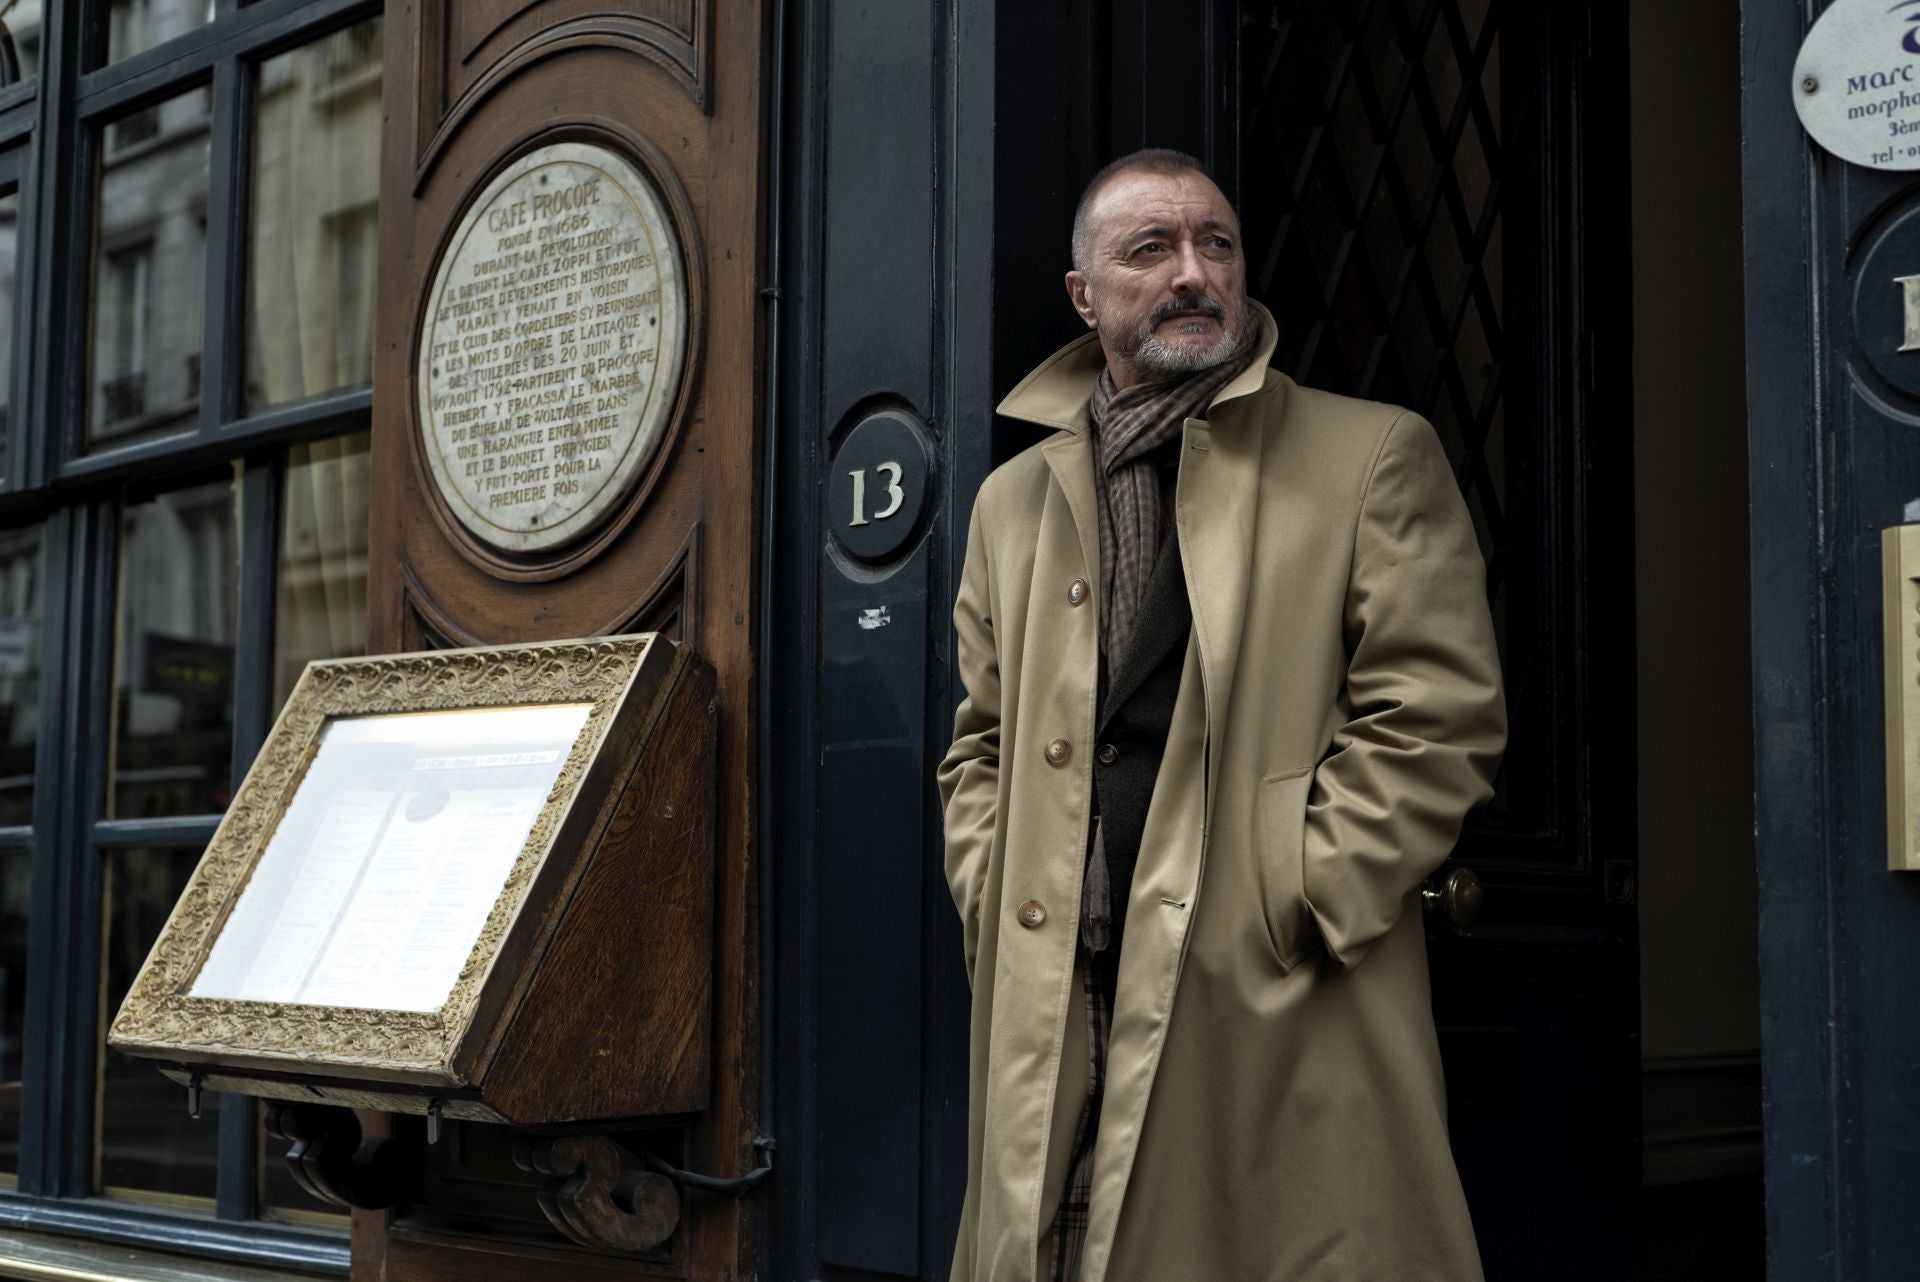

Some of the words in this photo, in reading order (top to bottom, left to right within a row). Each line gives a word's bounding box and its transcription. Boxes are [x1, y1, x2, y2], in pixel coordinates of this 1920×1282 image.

[533, 180, 601, 221] PROCOPE
[539, 225, 551, 240] EN
[556, 211, 590, 235] 1686
[460, 277, 499, 299] DEVINT
[503, 272, 516, 287] LE
[555, 252, 590, 273] ZOPPI
[597, 246, 612, 263] ET
[474, 252, 521, 277] DURANT
[525, 248, 537, 264] LA
[439, 307, 450, 321] LE
[456, 311, 498, 335] MARAT
[503, 308, 510, 323] Y
[516, 296, 558, 319] VENAIT
[567, 291, 582, 307] EN
[591, 279, 629, 301] VOISIN
[434, 343, 446, 360] ET
[448, 340, 459, 355] LE
[463, 332, 488, 351] CLUB
[492, 326, 511, 344] DES
[514, 310, 577, 338] CORDELIERS
[446, 356, 464, 373] LES
[469, 348, 499, 367] MOTS
[561, 329, 575, 346] DE
[449, 373, 468, 390] DES
[475, 358, 531, 384] TUILERIES
[534, 352, 555, 370] DES
[561, 345, 577, 364] 20
[583, 339, 611, 359] JUIN
[620, 334, 635, 350] ET
[484, 379, 512, 400] 1792
[516, 367, 577, 393] PARTIRENT
[582, 362, 595, 378] DU
[495, 402, 503, 416] Y
[508, 388, 566, 413] FRACASSA
[571, 384, 585, 399] LE
[590, 371, 640, 395] MARBRE
[452, 428, 466, 444] DU
[470, 418, 512, 440] BUREAU
[517, 414, 530, 429] DE
[536, 401, 591, 425] VOLTAIRE
[597, 392, 628, 412] DANS
[458, 444, 478, 461] UNE
[483, 430, 544, 455] HARANGUE
[466, 461, 479, 477] ET
[483, 458, 495, 473] LE
[500, 448, 545, 470] BONNET
[555, 435, 612, 459] PHRYGIEN
[476, 480, 483, 494] Y
[486, 474, 507, 491] FUT
[556, 459, 587, 478] POUR
[588, 456, 602, 472] LA
[848, 461, 905, 527] 13
